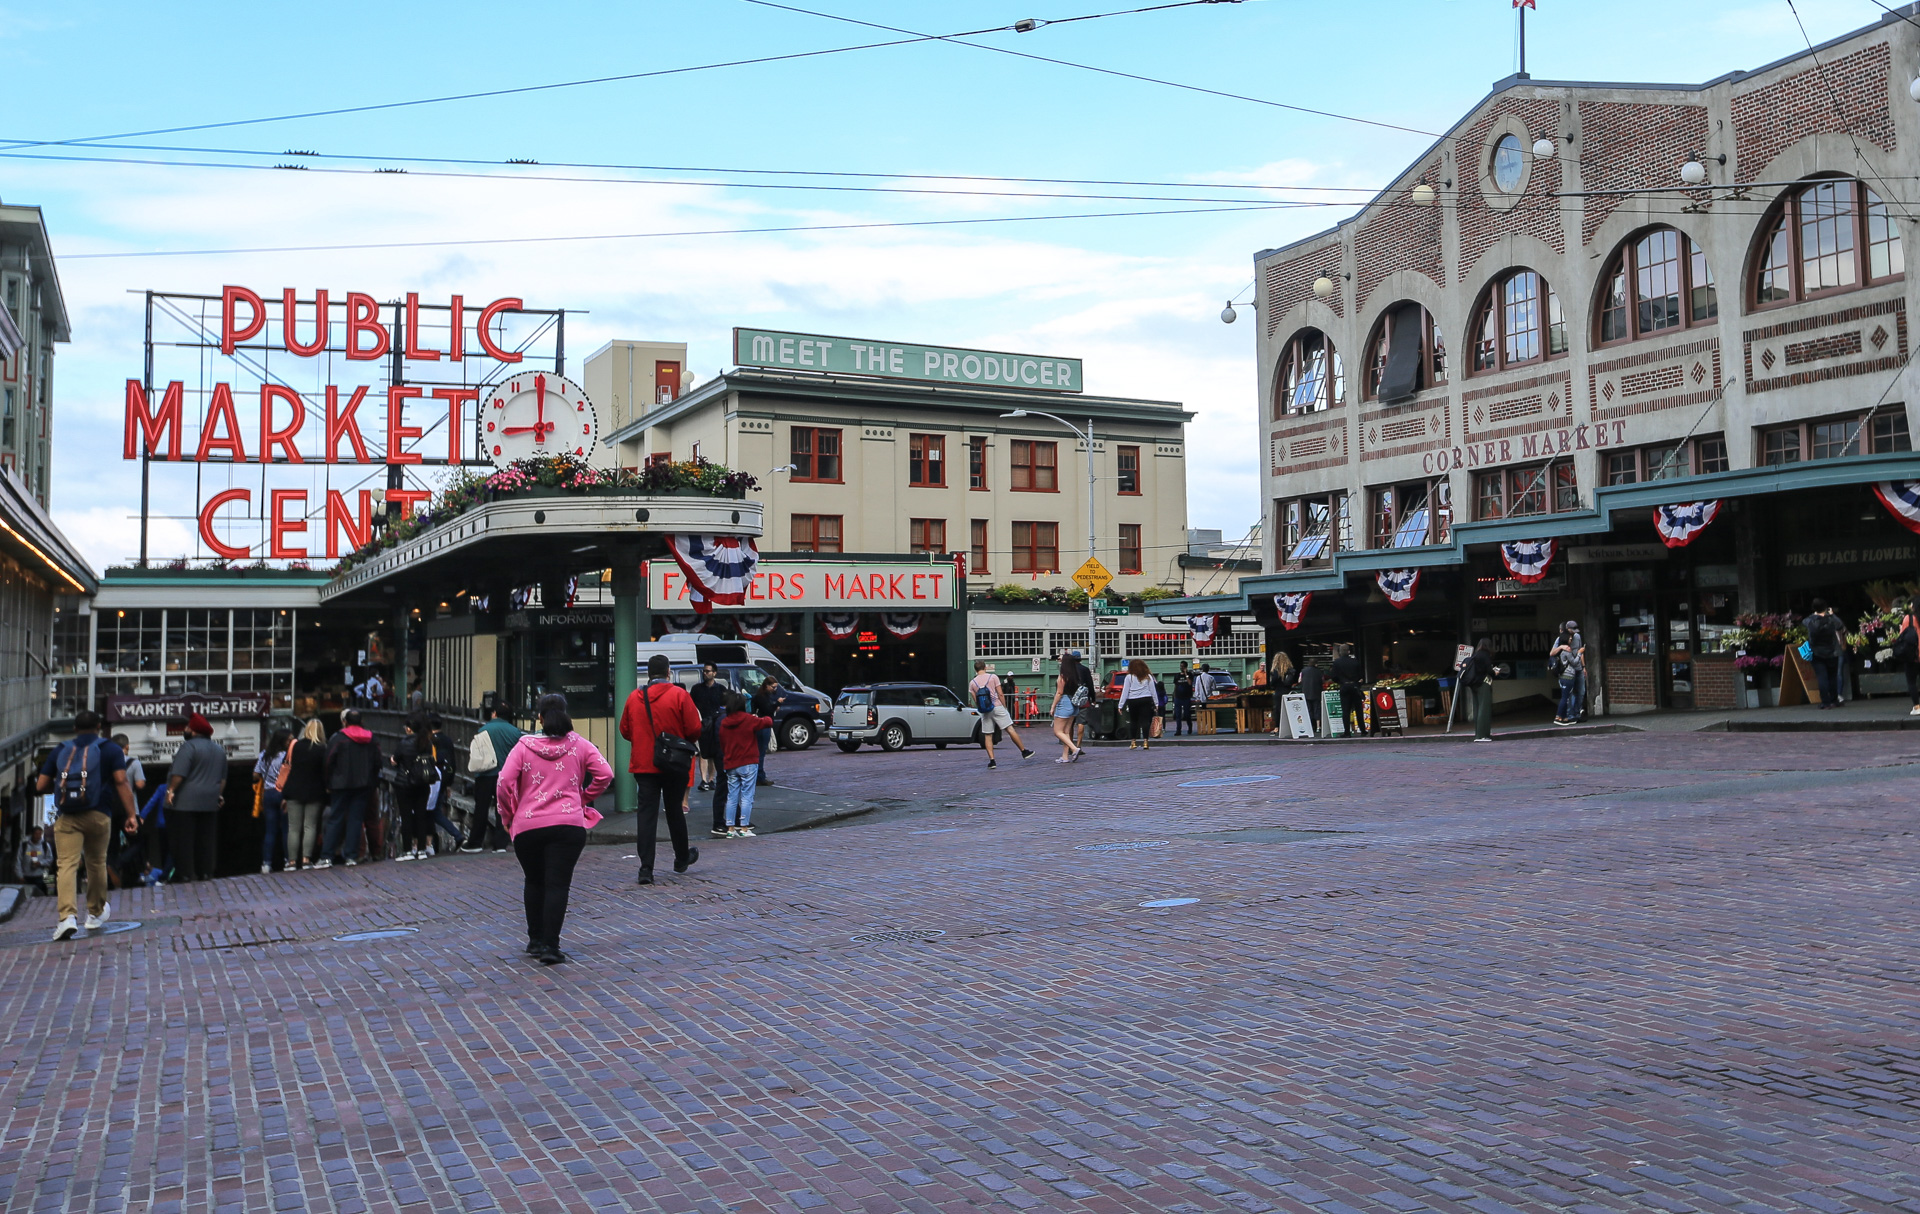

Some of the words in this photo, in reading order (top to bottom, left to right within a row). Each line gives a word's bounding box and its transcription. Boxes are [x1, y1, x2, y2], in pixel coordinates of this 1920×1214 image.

[221, 284, 523, 363] PUBLIC
[752, 335, 832, 367] MEET
[850, 343, 904, 373] THE
[924, 351, 1072, 386] PRODUCER
[511, 381, 520, 393] 11
[561, 383, 566, 394] 1
[493, 398, 505, 409] 10
[576, 400, 585, 411] 2
[123, 378, 478, 465] MARKET
[486, 421, 496, 432] 9
[582, 423, 590, 435] 3
[493, 444, 502, 456] 8
[574, 446, 584, 457] 4
[1422, 439, 1513, 474] CORNER
[1522, 420, 1626, 459] MARKET
[199, 488, 456, 559] CENT
[1785, 552, 1816, 567] PIKE
[1818, 549, 1858, 565] PLACE
[663, 572, 805, 600] FERS
[824, 573, 943, 600] MARKET
[1499, 581, 1512, 591] The
[539, 614, 613, 625] INFORMATION
[1491, 633, 1518, 653] CAN
[1522, 632, 1549, 652] CAN
[121, 703, 185, 717] MARKET
[191, 700, 258, 715] THEATER
